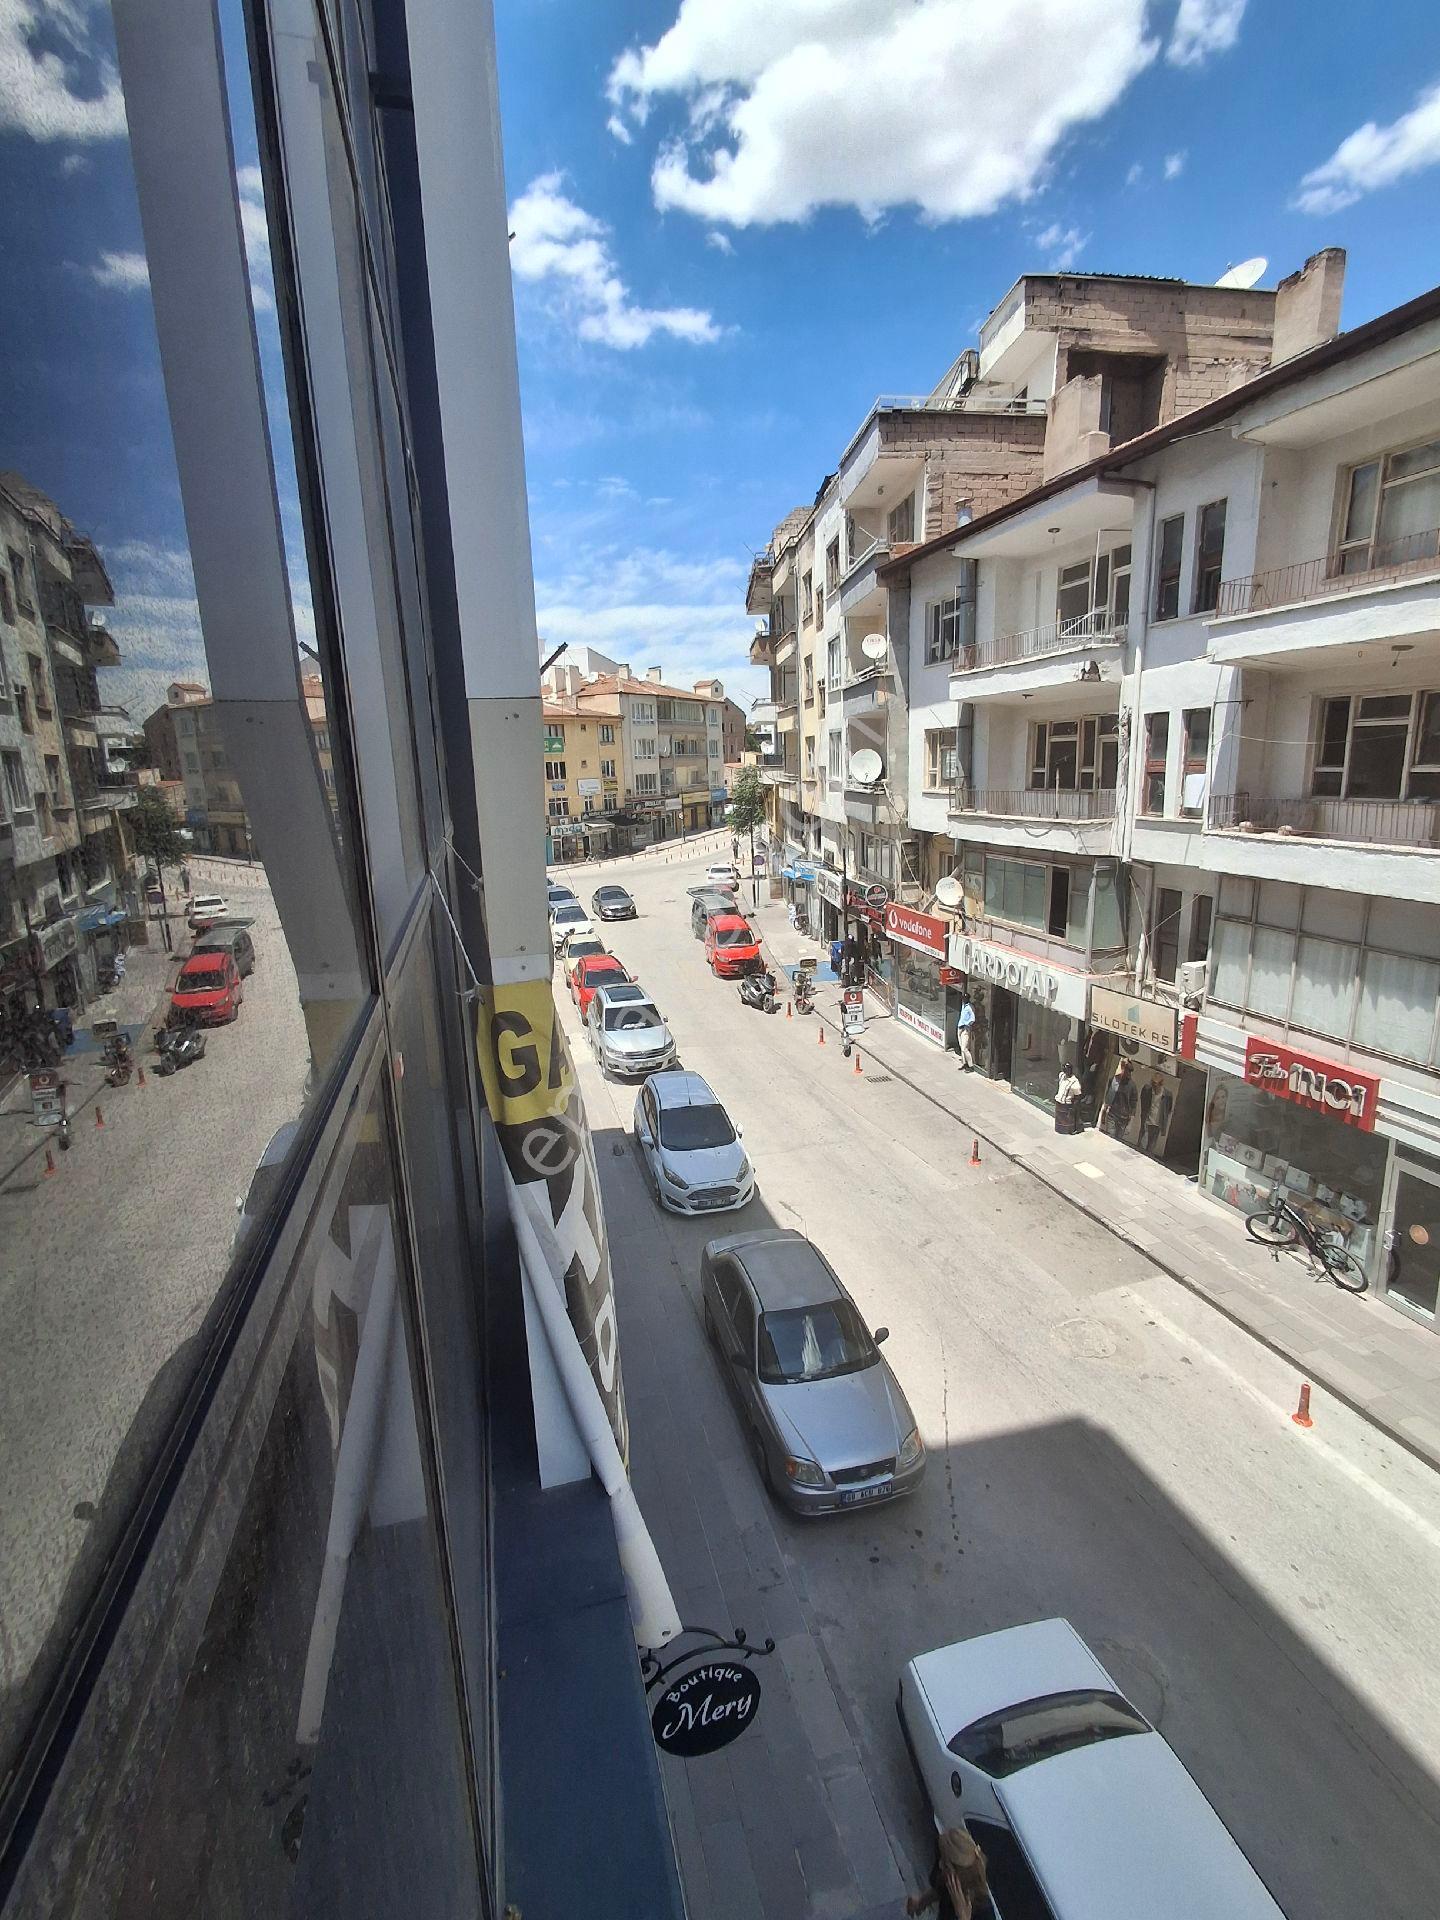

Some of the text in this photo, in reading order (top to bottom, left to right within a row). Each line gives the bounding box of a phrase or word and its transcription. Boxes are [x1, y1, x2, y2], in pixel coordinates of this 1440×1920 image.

[898, 918, 932, 940] vodafone
[666, 1666, 743, 1703] Boutique
[661, 1693, 753, 1740] Mery
